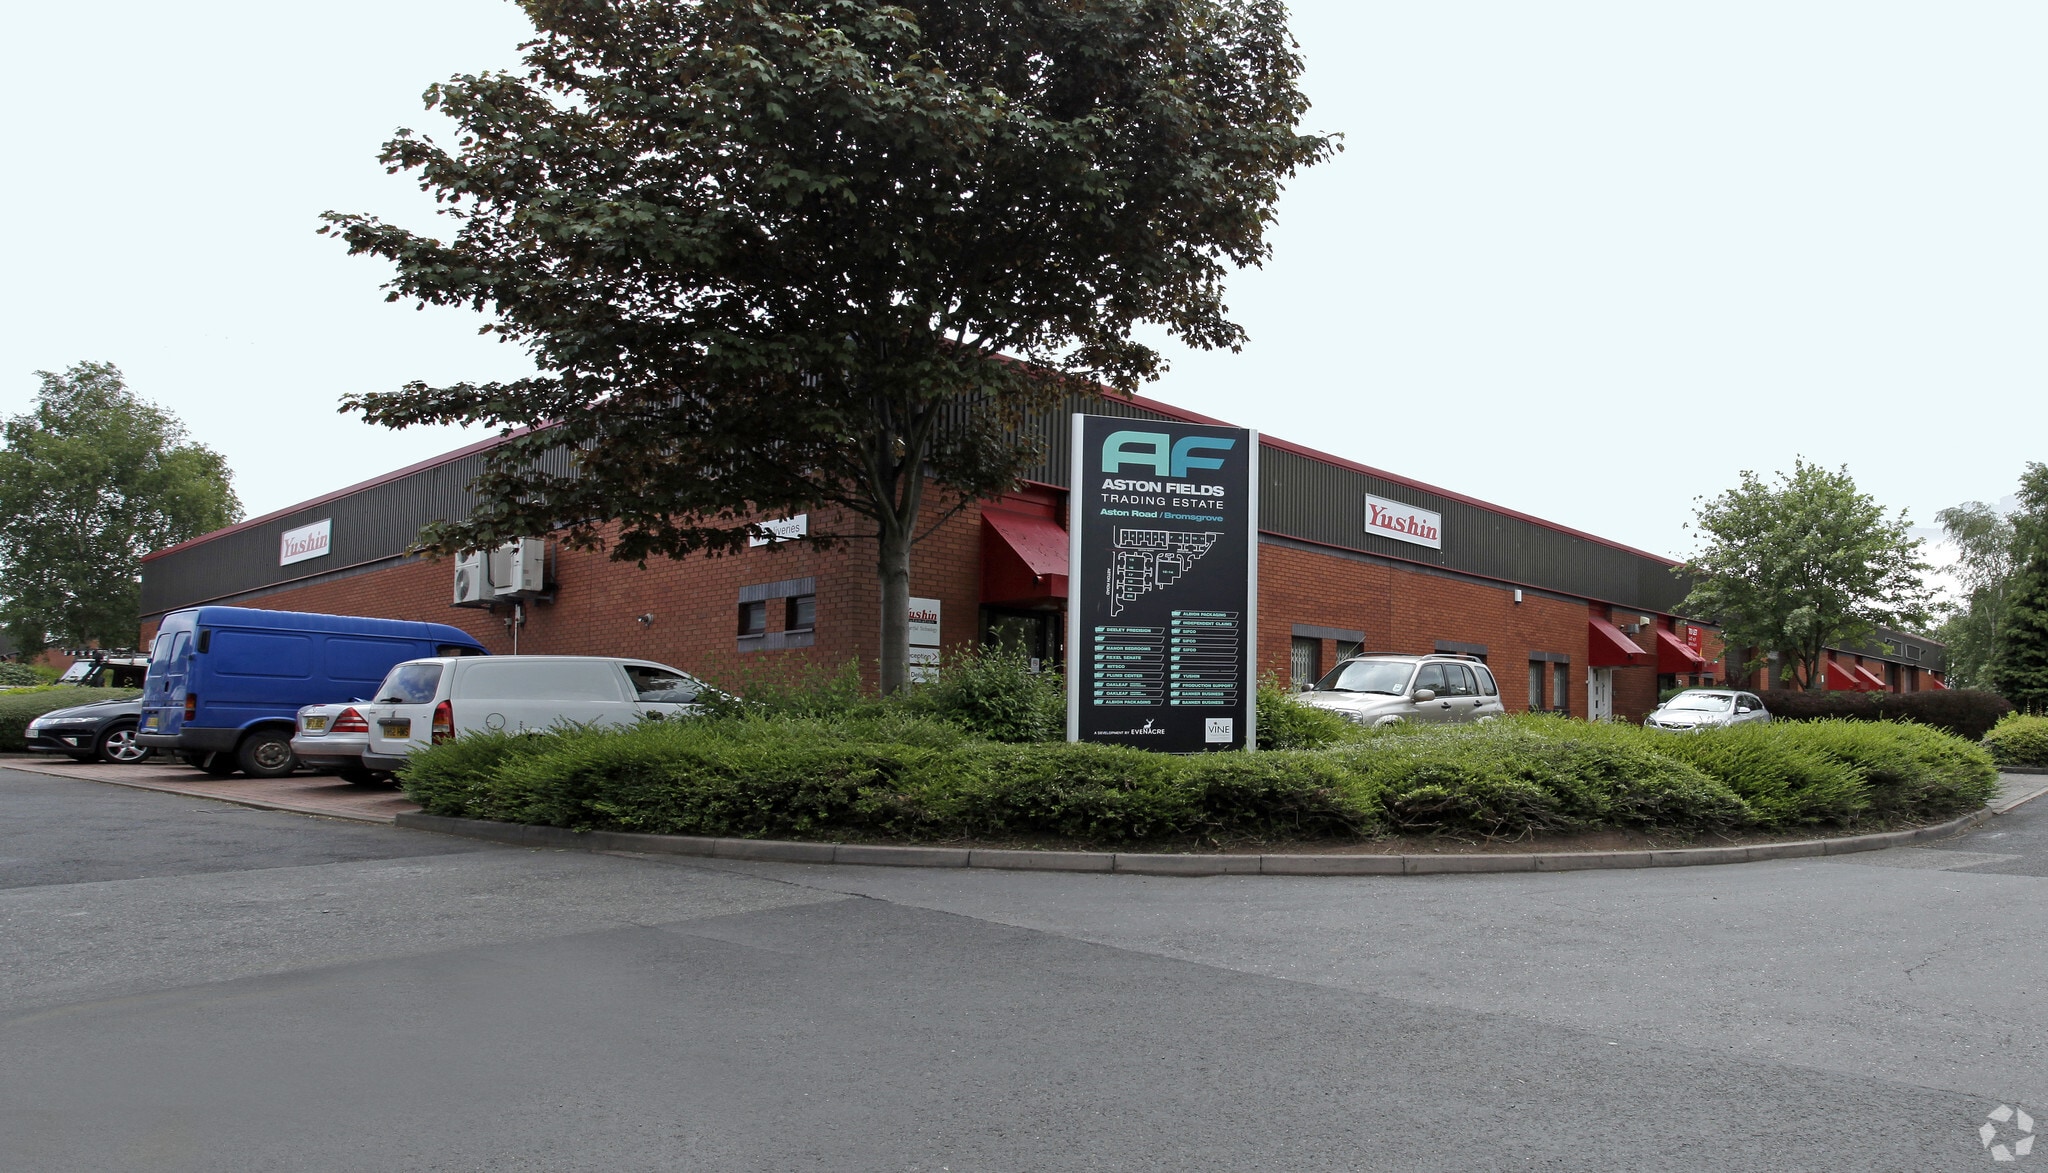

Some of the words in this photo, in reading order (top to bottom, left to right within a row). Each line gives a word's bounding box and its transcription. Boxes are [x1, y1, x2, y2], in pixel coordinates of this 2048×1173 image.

[1102, 430, 1236, 478] AF
[1102, 479, 1162, 492] ASTON
[1166, 482, 1225, 497] FIELDS
[1101, 494, 1166, 506] TRADING
[1173, 498, 1224, 510] ESTATE
[1100, 508, 1129, 516] Aston
[1132, 510, 1158, 518] Road
[1164, 512, 1224, 522] Bromsgrove
[1369, 503, 1438, 541] Yushin
[284, 530, 328, 558] Yushin
[909, 652, 932, 661] ception
[1208, 725, 1230, 734] VINE
